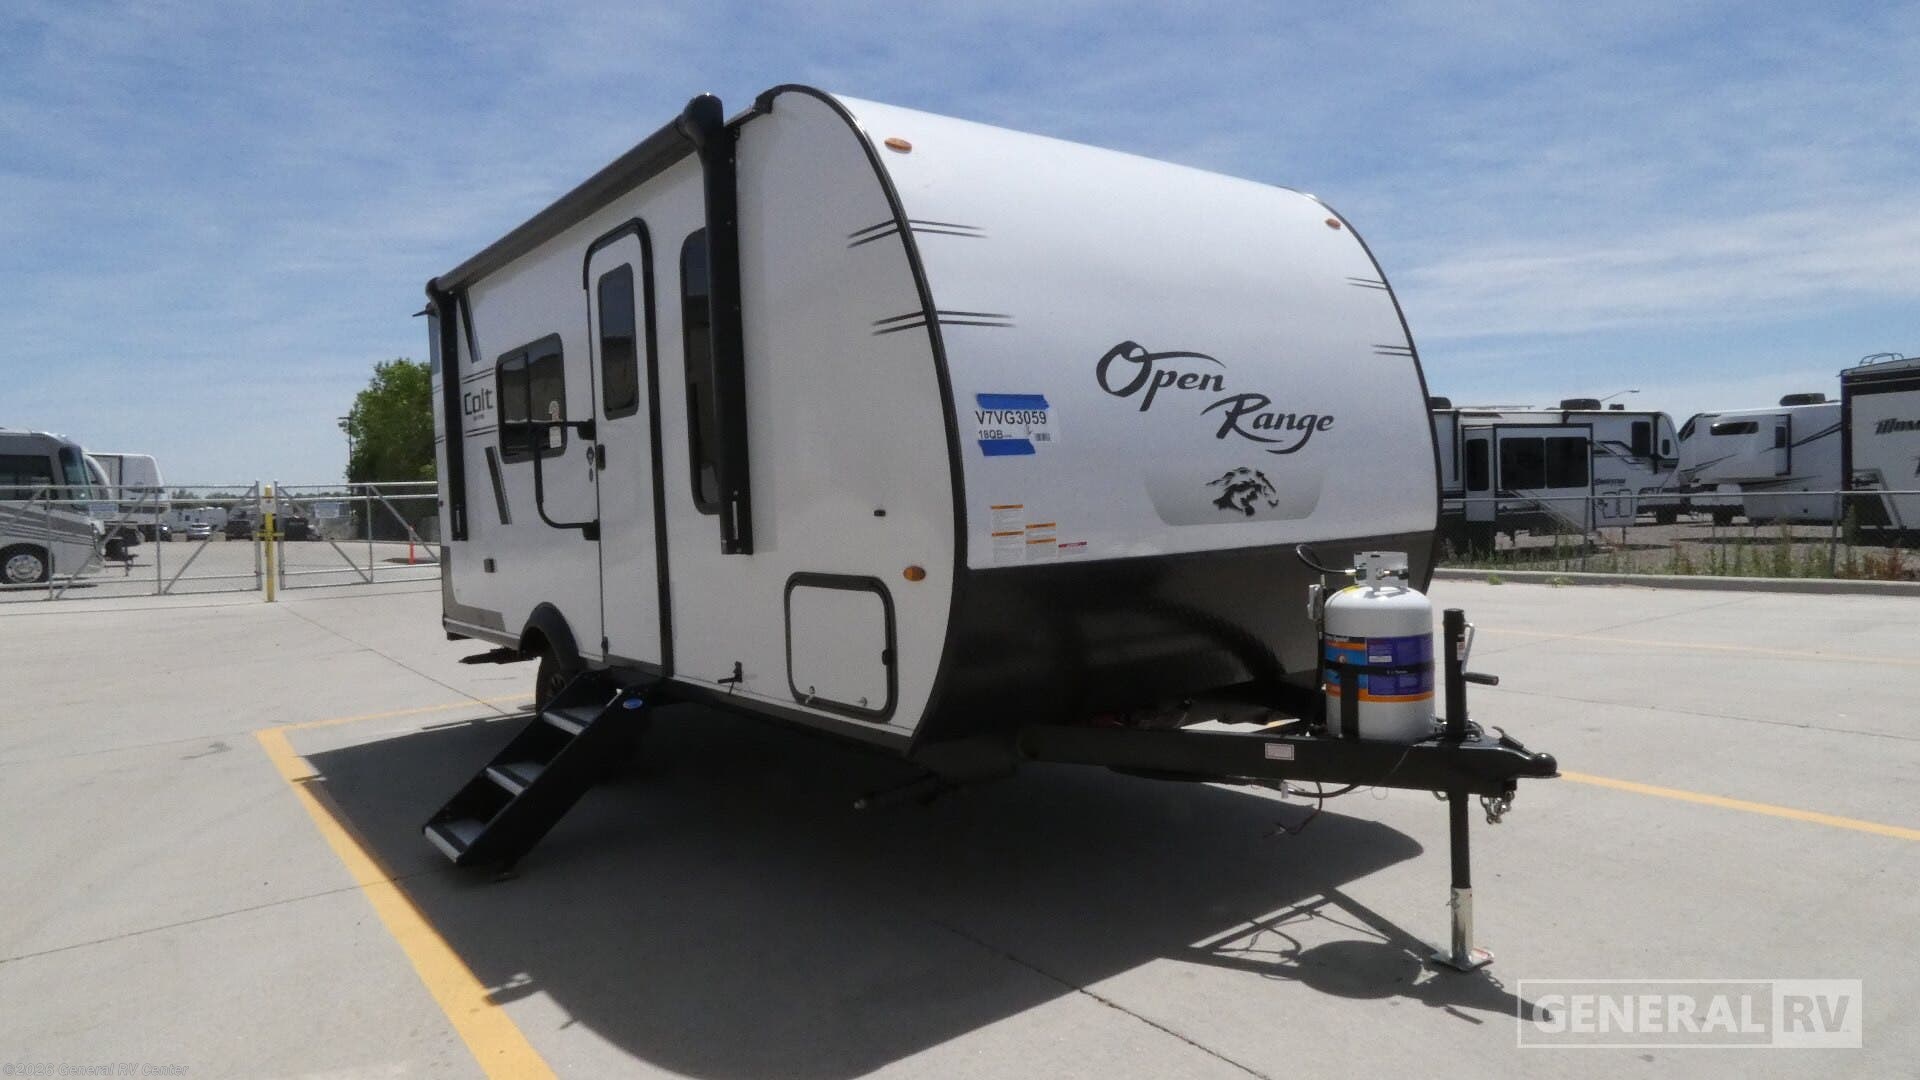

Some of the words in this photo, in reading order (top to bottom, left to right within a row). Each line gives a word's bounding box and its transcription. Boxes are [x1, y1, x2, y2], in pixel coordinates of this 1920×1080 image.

[1096, 340, 1226, 412] Open
[464, 388, 493, 415] Colt
[975, 410, 1047, 425] V7VG3059
[1201, 393, 1334, 454] Range
